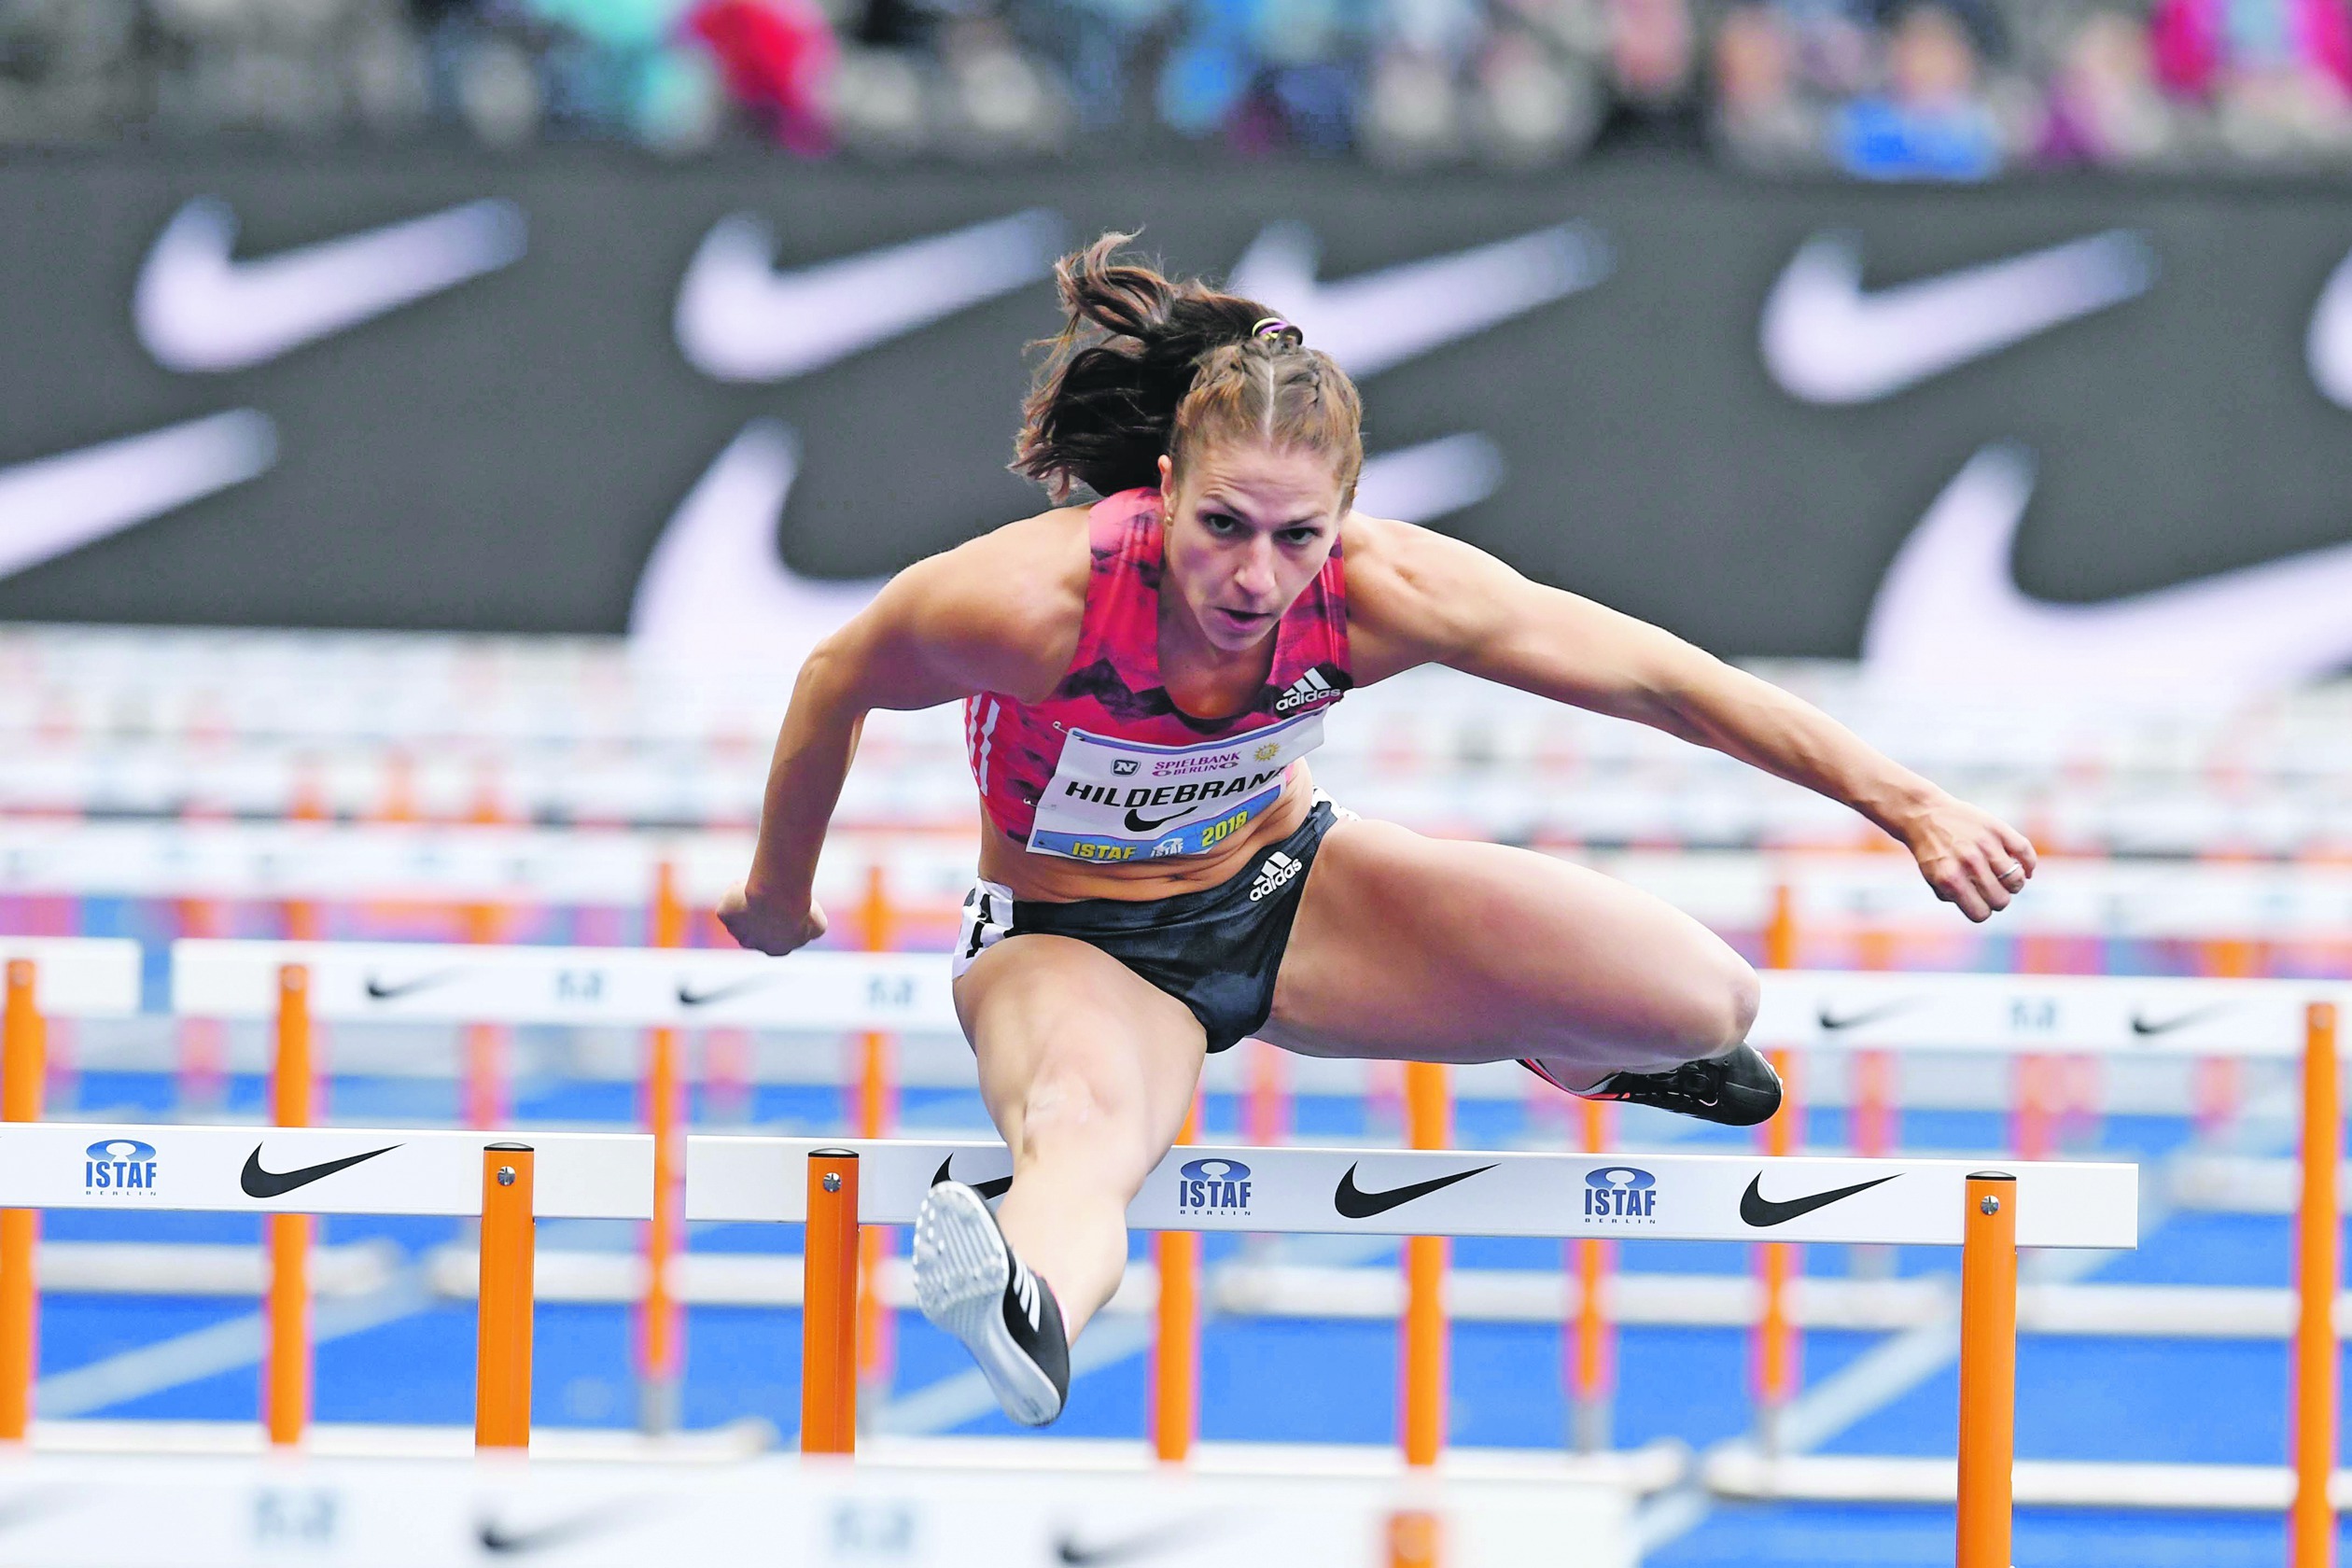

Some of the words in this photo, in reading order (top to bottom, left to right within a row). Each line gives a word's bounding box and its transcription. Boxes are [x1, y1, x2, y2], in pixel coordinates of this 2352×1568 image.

[1276, 689, 1340, 711] adidas
[1155, 750, 1240, 770] SPIELBANK
[1173, 763, 1220, 776] BERLIN
[1065, 766, 1286, 807] HILDEBRAN
[1072, 842, 1137, 860] ISTAF
[1201, 810, 1248, 847] 2018
[1249, 858, 1303, 902] adidas
[86, 1161, 158, 1188] ISTAF
[1180, 1181, 1252, 1208] ISTAF
[1585, 1189, 1657, 1216] ISTAF
